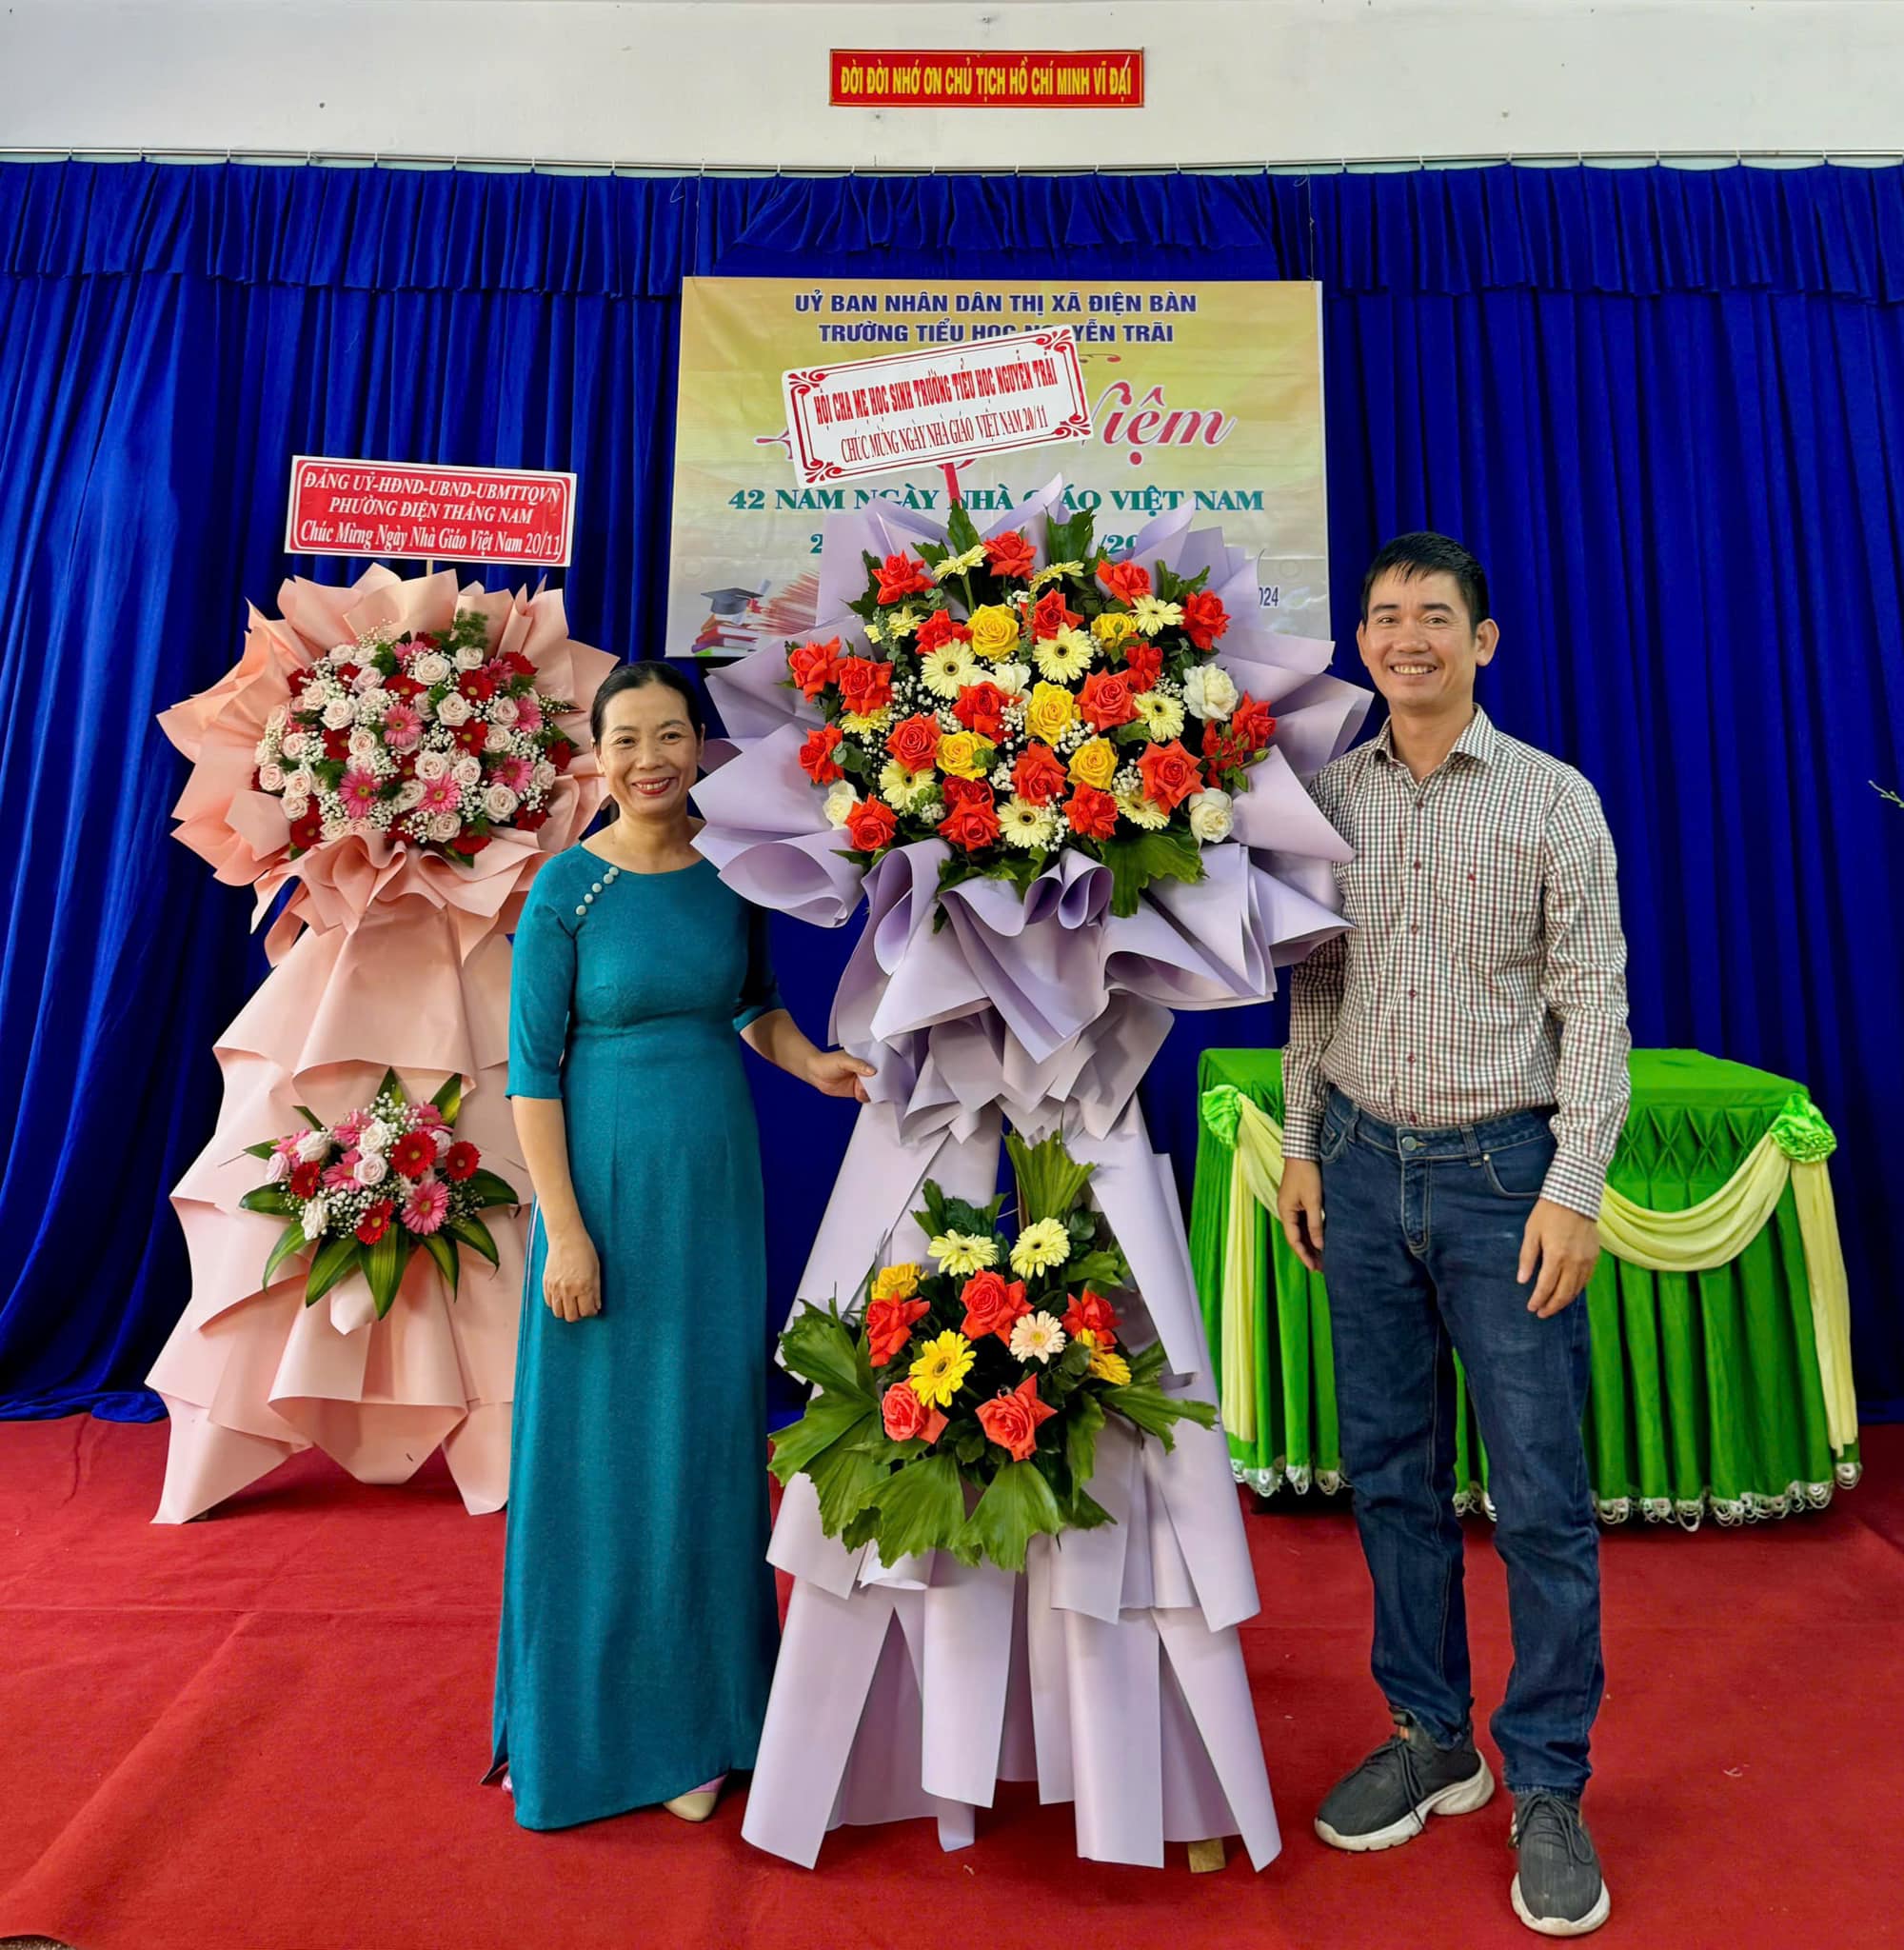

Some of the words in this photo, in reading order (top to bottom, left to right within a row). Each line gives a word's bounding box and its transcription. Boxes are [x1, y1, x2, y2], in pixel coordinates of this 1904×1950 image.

[841, 59, 863, 95] ĐỜI
[866, 59, 889, 95] ĐỜI
[893, 59, 922, 95] NHỚ
[945, 56, 973, 95] CHỦ
[976, 67, 1006, 103] TỊCH
[1009, 55, 1028, 95] HỒ
[1031, 60, 1054, 95] CHÍ
[1057, 67, 1090, 95] MINH
[795, 289, 823, 312] UỶ
[831, 294, 877, 312] BAN
[884, 290, 948, 312] NHÂN
[956, 290, 1002, 312] DÂN
[1009, 294, 1043, 316] THỊ
[1051, 291, 1081, 312] XÃ
[1088, 290, 1141, 316] ĐIỆN
[1149, 290, 1197, 312] BÀN
[819, 320, 908, 342] TRƯỜNG
[916, 317, 964, 342] TIỂU
[1122, 322, 1173, 342] TRÃI
[832, 391, 854, 422] CHA
[852, 388, 869, 425] MẸ
[868, 385, 889, 422] HỌC
[889, 381, 914, 412] SINH
[912, 368, 953, 408] TRƯỜNG
[950, 357, 976, 401] TIỂU
[975, 368, 996, 404] HỌC
[841, 428, 870, 463] CHÚC
[869, 424, 900, 458] MỪNG
[899, 419, 926, 452] NGÀY
[926, 412, 950, 448] NHÀ
[949, 410, 975, 444] GIÁO
[975, 408, 1000, 442] VIỆT
[999, 409, 1024, 435] NAM
[1021, 405, 1048, 430] 20/11
[328, 495, 398, 516] PHƯỜNG
[400, 500, 440, 522] ĐIỆN
[497, 507, 534, 525] NAM
[728, 489, 765, 510] 42
[1110, 485, 1184, 517] VIỆT
[1193, 490, 1264, 510] NAM
[301, 519, 334, 543] Chúc
[335, 522, 374, 550] Mừng
[375, 524, 408, 551] Ngày
[409, 526, 436, 548] Nhà
[439, 527, 466, 550] Giáo
[470, 529, 493, 556] Việt
[495, 531, 524, 552] Nam
[525, 531, 561, 557] 20/11
